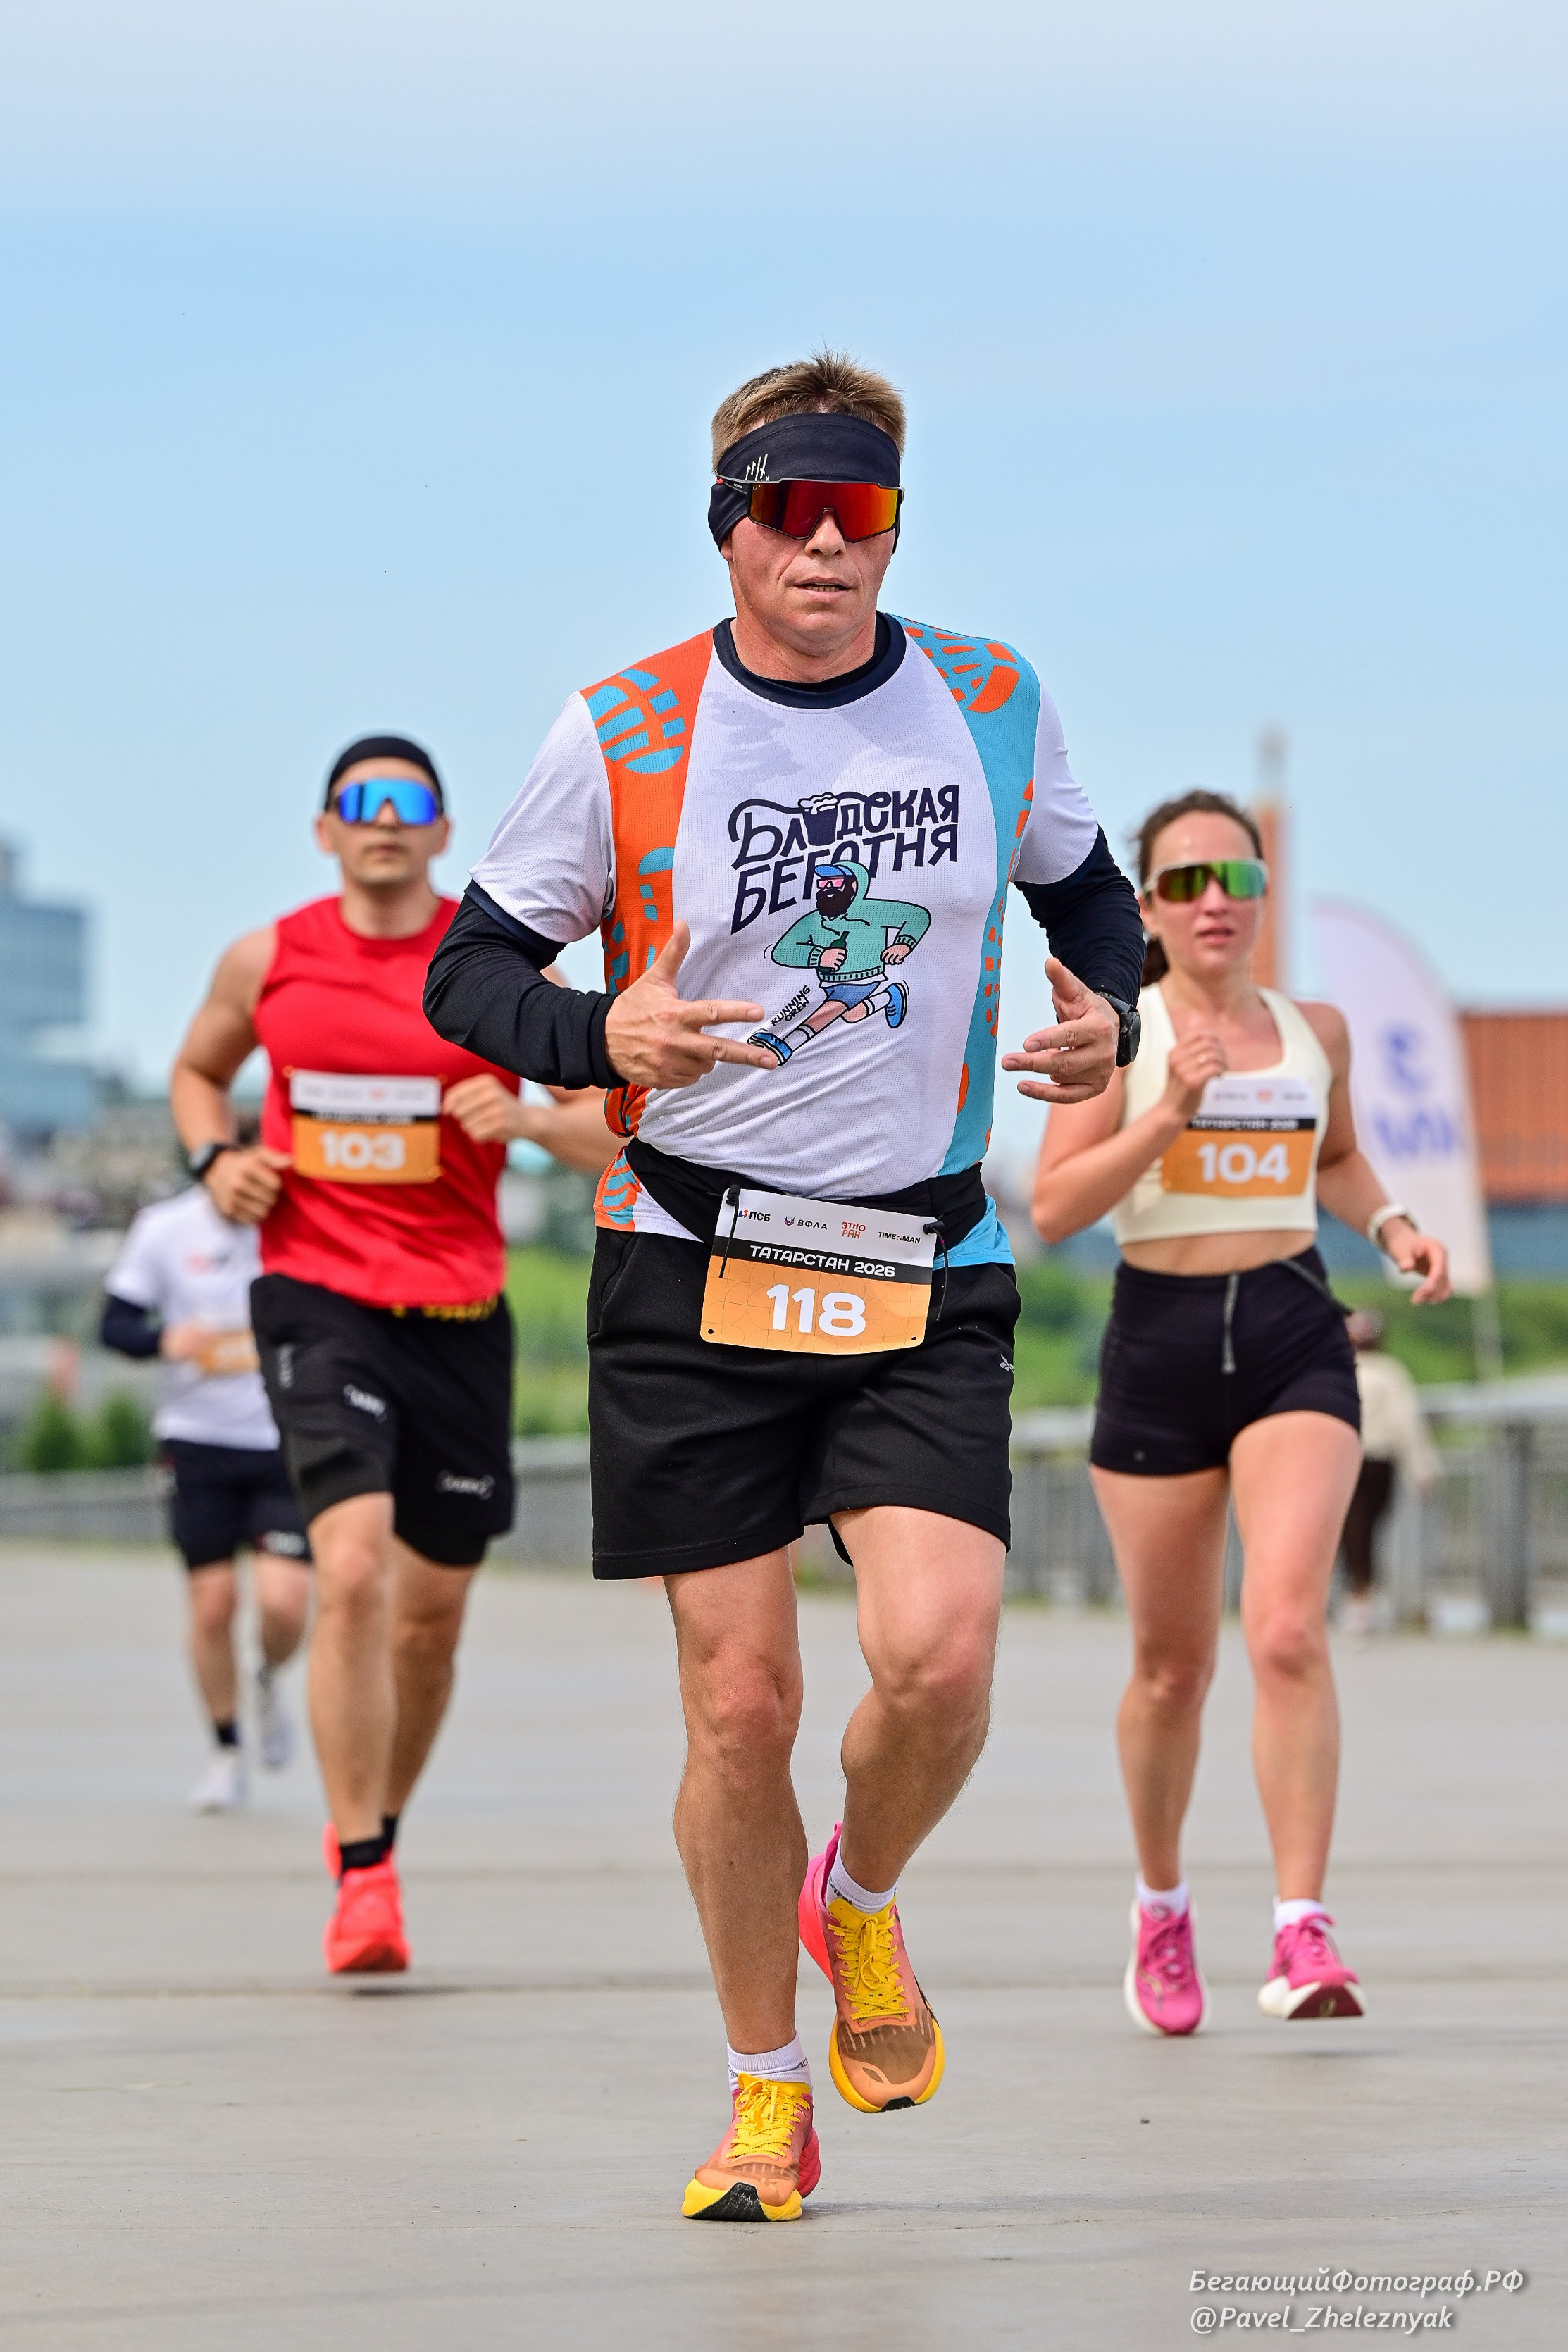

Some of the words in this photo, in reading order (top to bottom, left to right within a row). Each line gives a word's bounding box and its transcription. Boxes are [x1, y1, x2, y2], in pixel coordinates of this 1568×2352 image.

[728, 784, 959, 870] БЛДСКАЯ
[770, 985, 811, 1026] RUNNING
[785, 997, 810, 1021] CREW
[321, 1131, 405, 1171] 103
[1197, 1141, 1290, 1184] 104
[749, 1211, 771, 1222] ПСБ
[797, 1219, 828, 1231] ВФЛА
[749, 1245, 850, 1271] ТАТАРСТАН
[854, 1261, 895, 1278] 2026
[766, 1283, 866, 1337] 118
